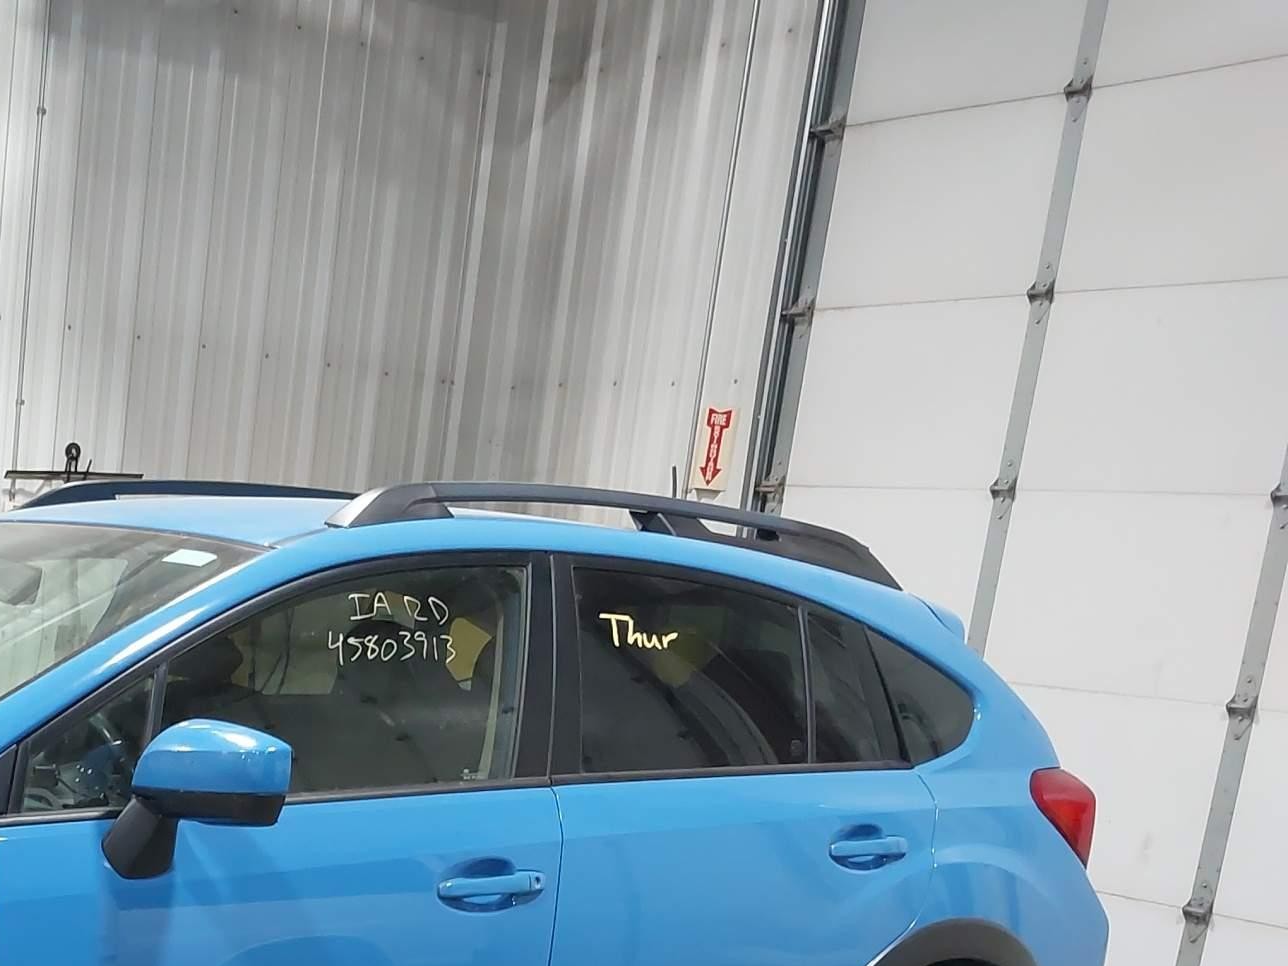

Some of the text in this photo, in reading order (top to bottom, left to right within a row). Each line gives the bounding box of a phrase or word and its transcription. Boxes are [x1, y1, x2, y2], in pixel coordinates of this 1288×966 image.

[710, 413, 728, 425] FIRE
[328, 630, 457, 667] 45803913
[598, 612, 678, 650] Thur
